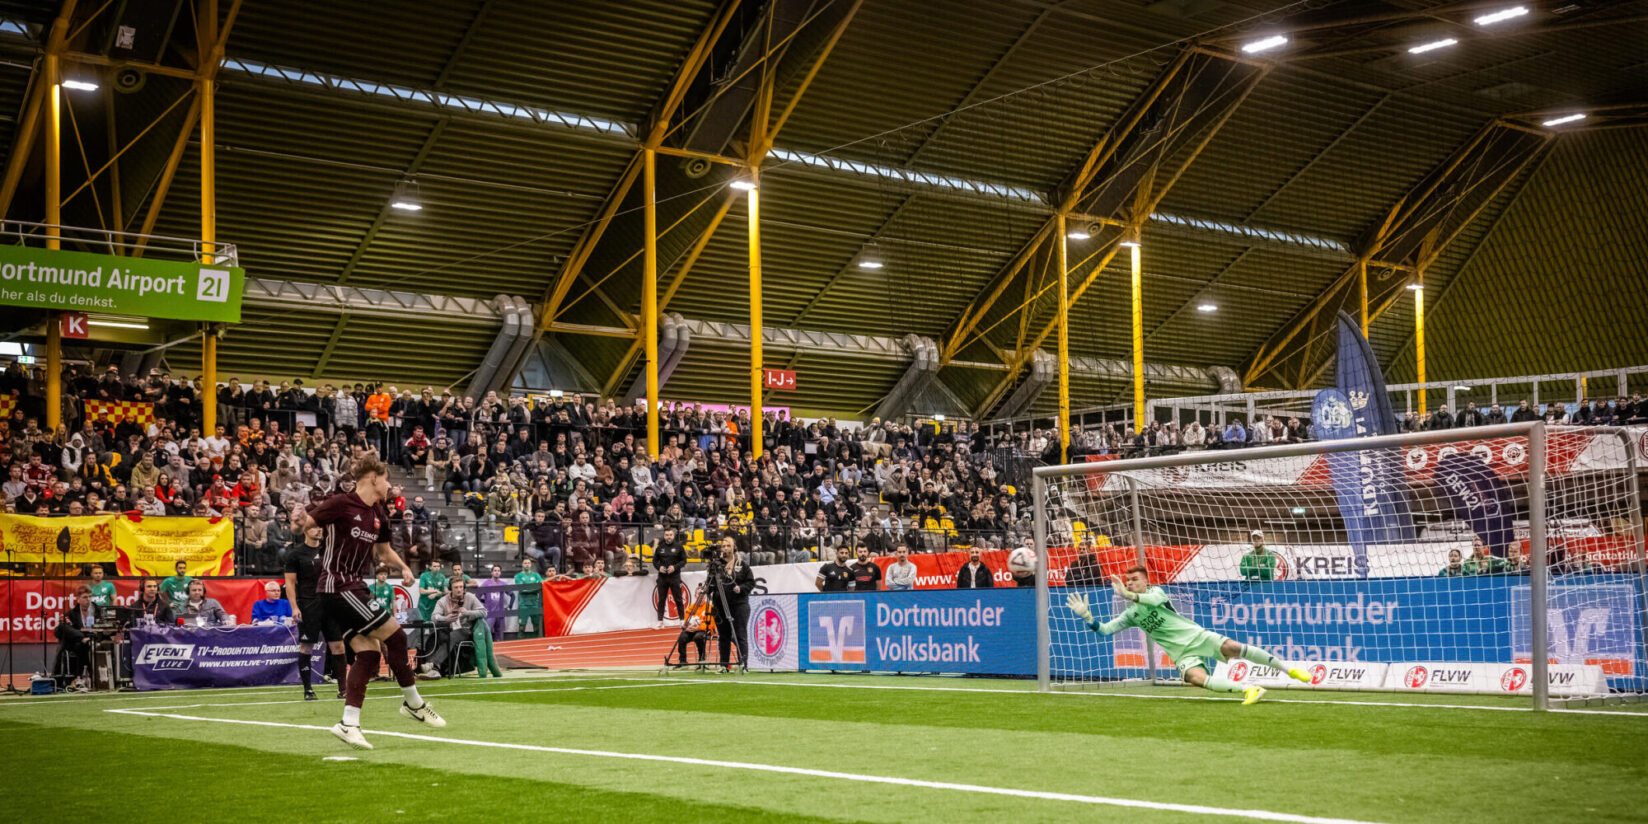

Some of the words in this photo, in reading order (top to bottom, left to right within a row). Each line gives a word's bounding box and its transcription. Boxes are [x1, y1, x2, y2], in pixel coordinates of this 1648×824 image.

[0, 262, 102, 287] ortmund
[107, 268, 186, 296] Airport
[201, 276, 222, 297] 21
[26, 290, 46, 302] als
[49, 292, 66, 304] du
[69, 294, 117, 308] denkst.
[68, 316, 85, 335] K
[1296, 556, 1370, 575] KREIS
[877, 600, 1004, 628] Dortmunder
[1211, 592, 1398, 625] Dortmunder
[144, 647, 187, 660] EVENT
[876, 635, 980, 662] Volksbank
[1249, 665, 1281, 677] FLVW
[1329, 668, 1366, 680] FLVW
[1431, 670, 1472, 682] FLVW
